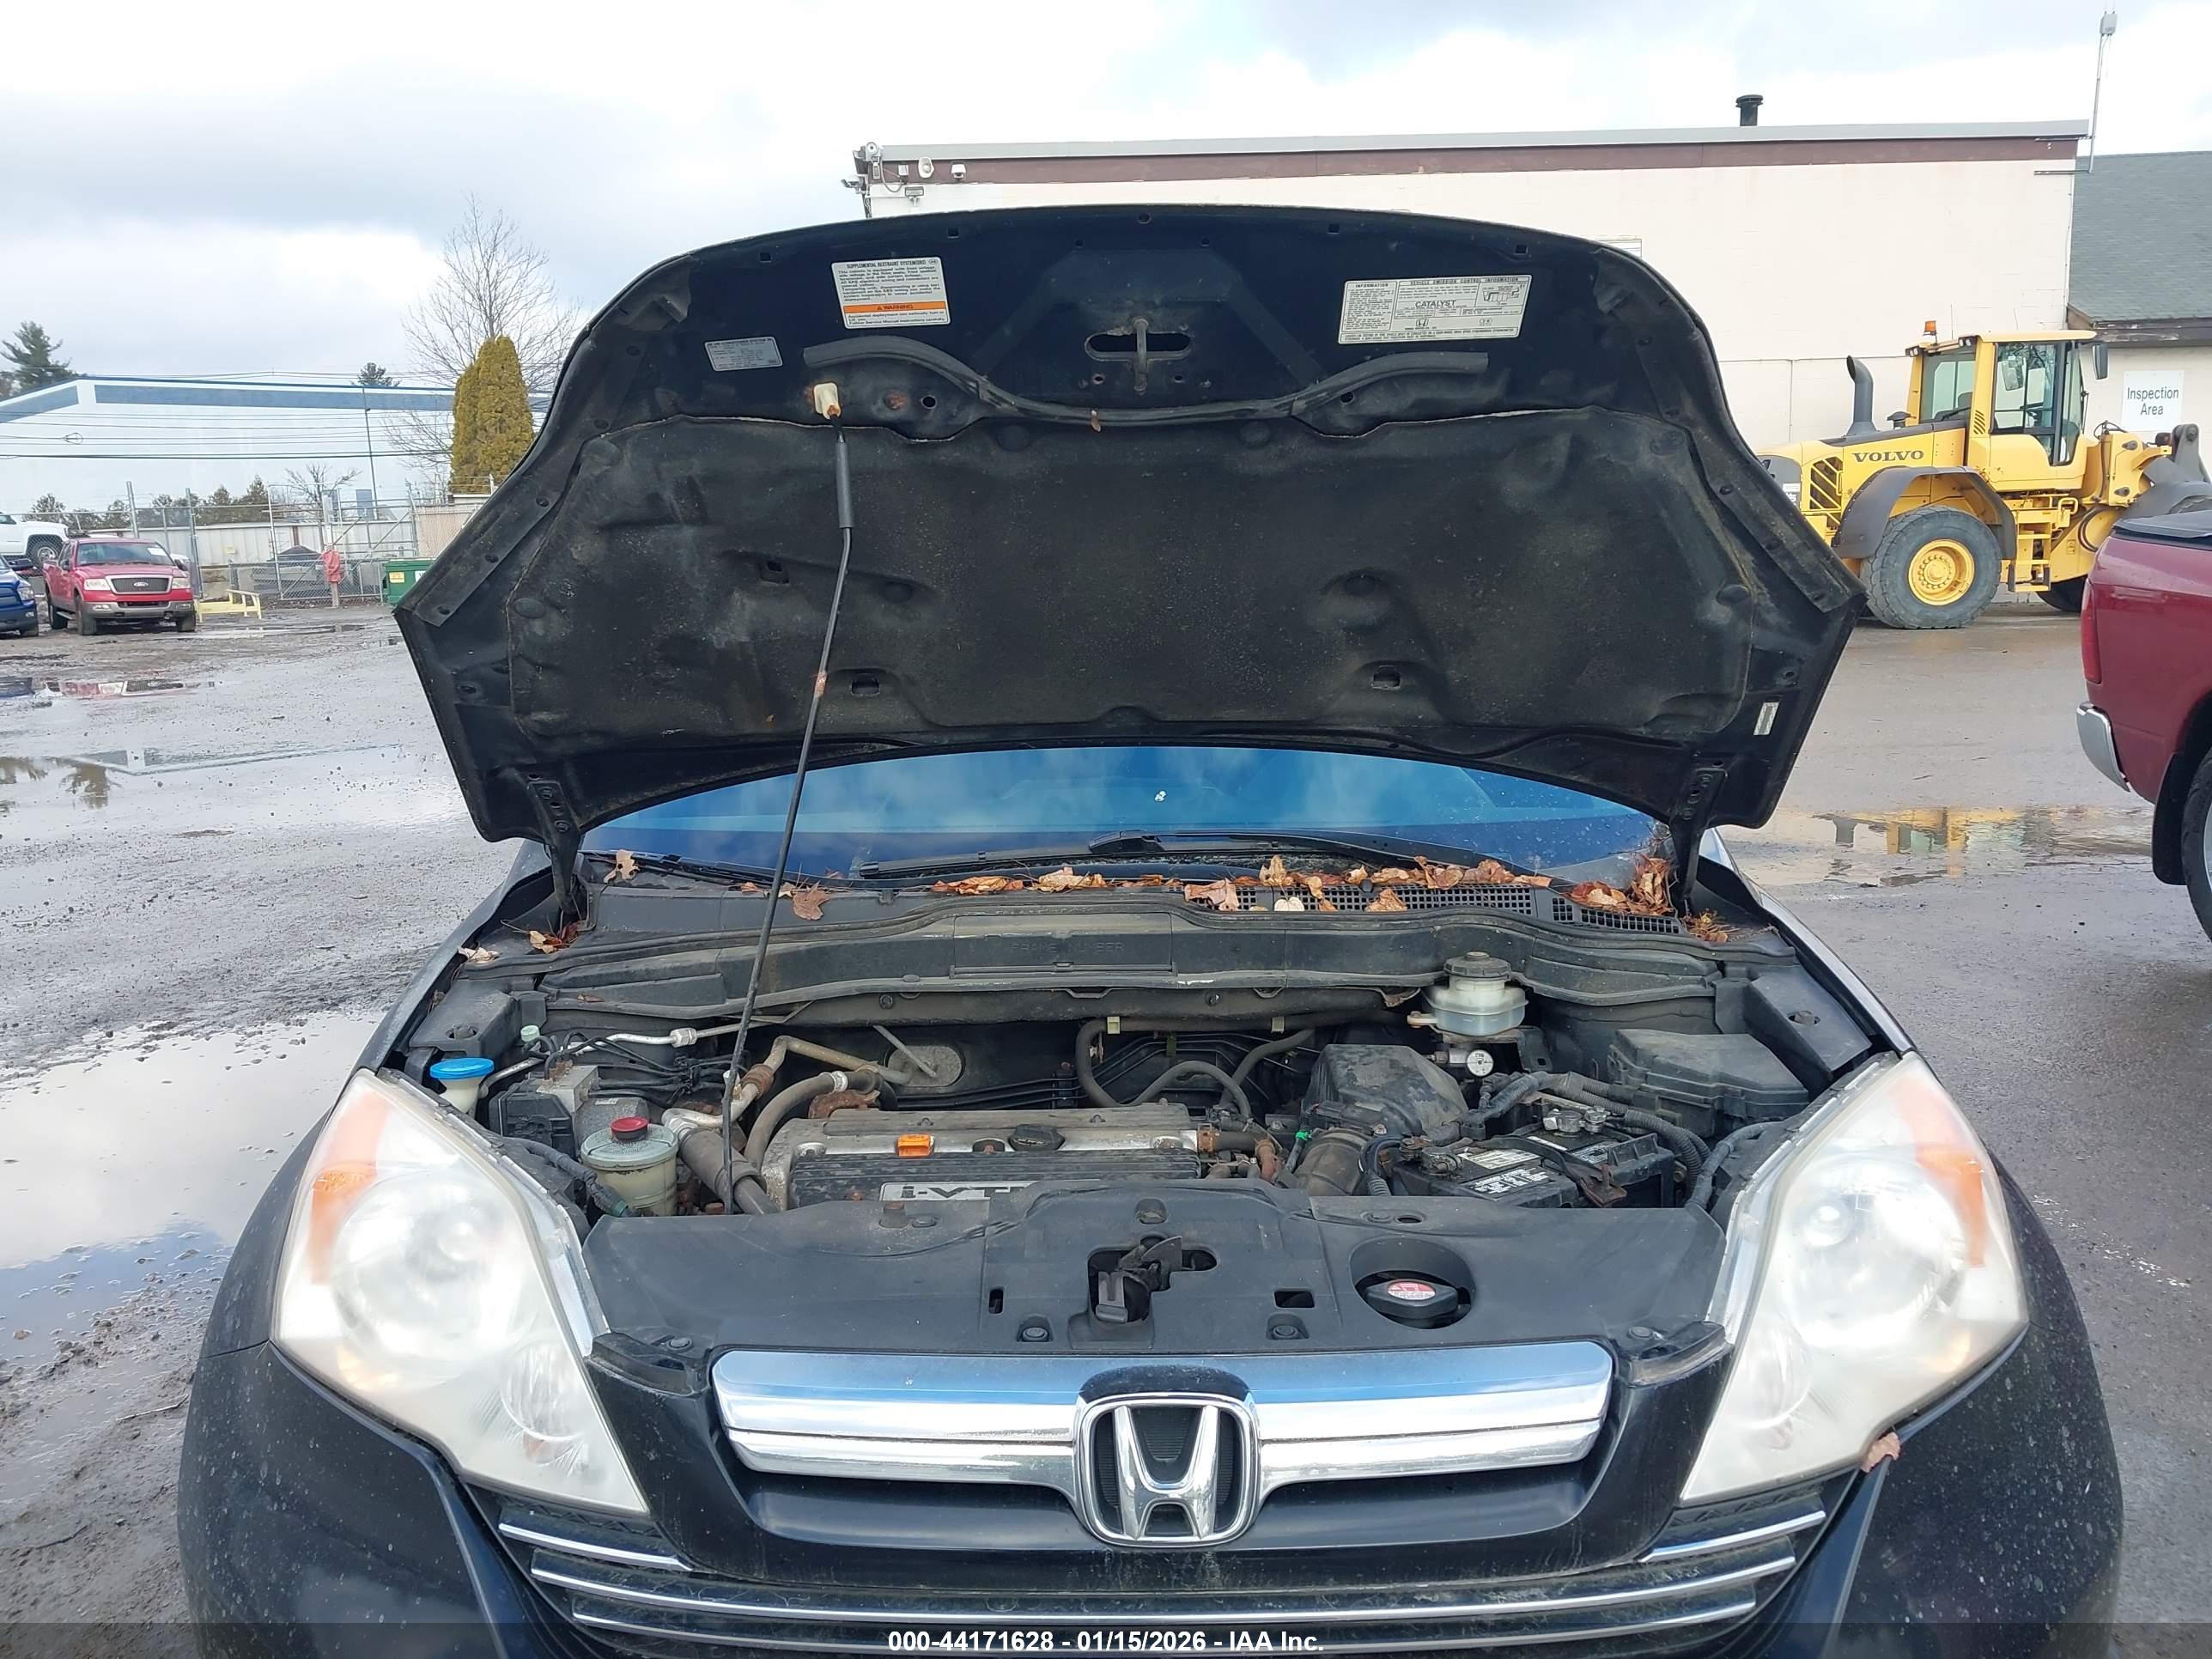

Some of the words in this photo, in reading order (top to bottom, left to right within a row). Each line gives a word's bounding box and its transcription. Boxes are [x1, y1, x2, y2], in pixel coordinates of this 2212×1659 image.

[2127, 386, 2179, 402] Inspection
[2141, 403, 2163, 415] Area
[1851, 450, 1923, 462] VOLVO
